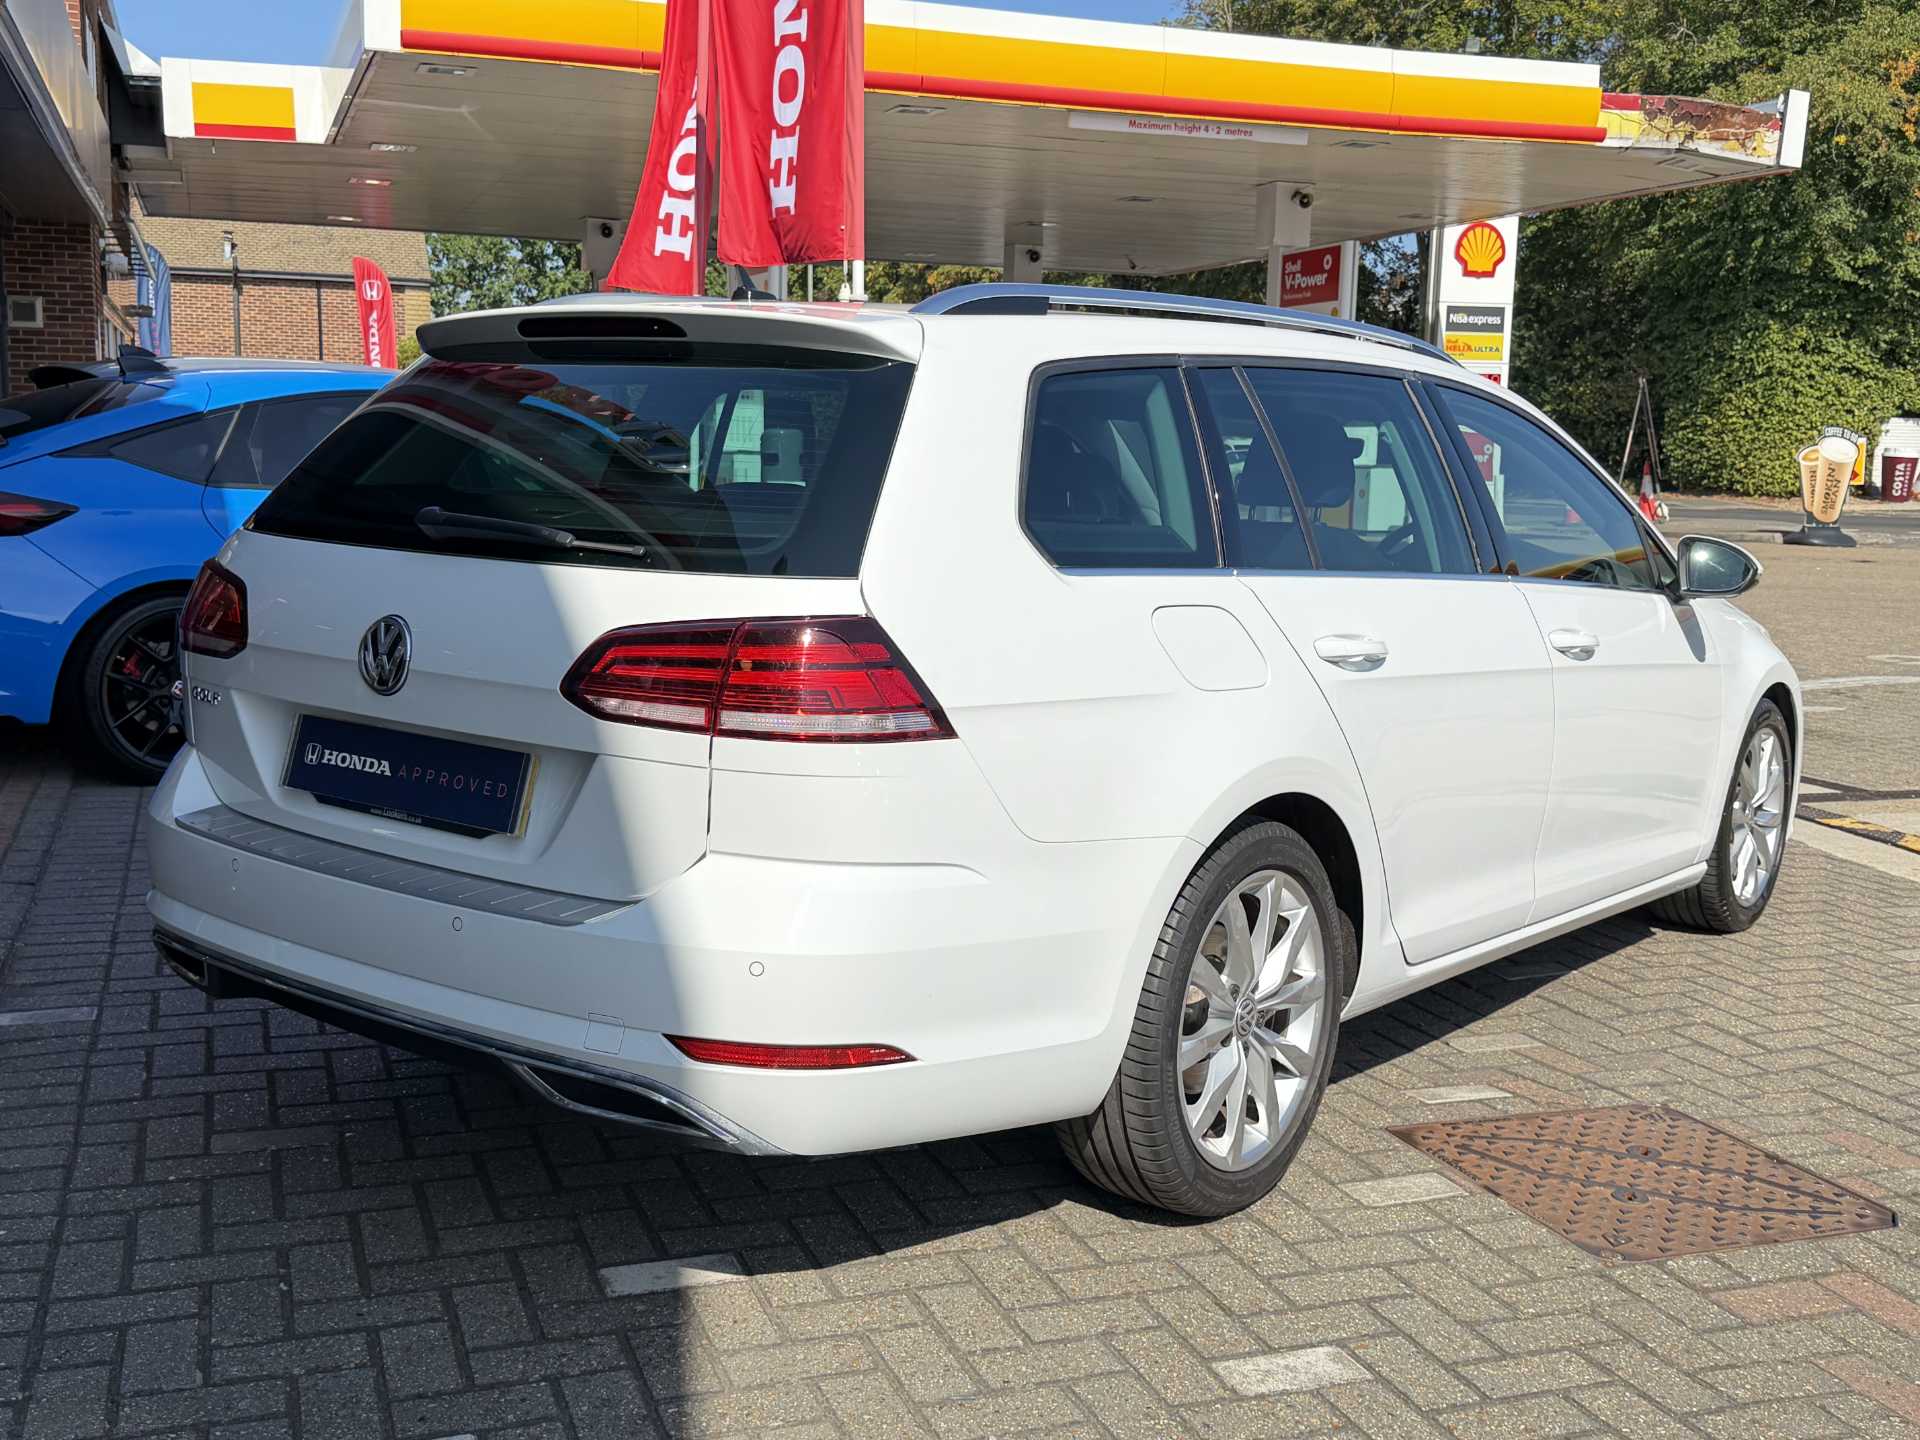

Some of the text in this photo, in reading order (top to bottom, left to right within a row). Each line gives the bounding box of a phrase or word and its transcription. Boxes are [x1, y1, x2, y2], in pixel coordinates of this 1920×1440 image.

[1128, 118, 1172, 132] Maximum
[1173, 122, 1202, 135] height
[1224, 127, 1253, 138] metres
[1284, 259, 1302, 274] Shell
[1283, 271, 1328, 290] V-Power
[1449, 313, 1502, 326] Nisa express
[1474, 345, 1500, 353] ULTRA
[1892, 462, 1906, 497] COSTA
[1829, 478, 1841, 510] BEAN
[191, 686, 222, 705] GOLF
[321, 749, 509, 799] HONDA APPROVED
